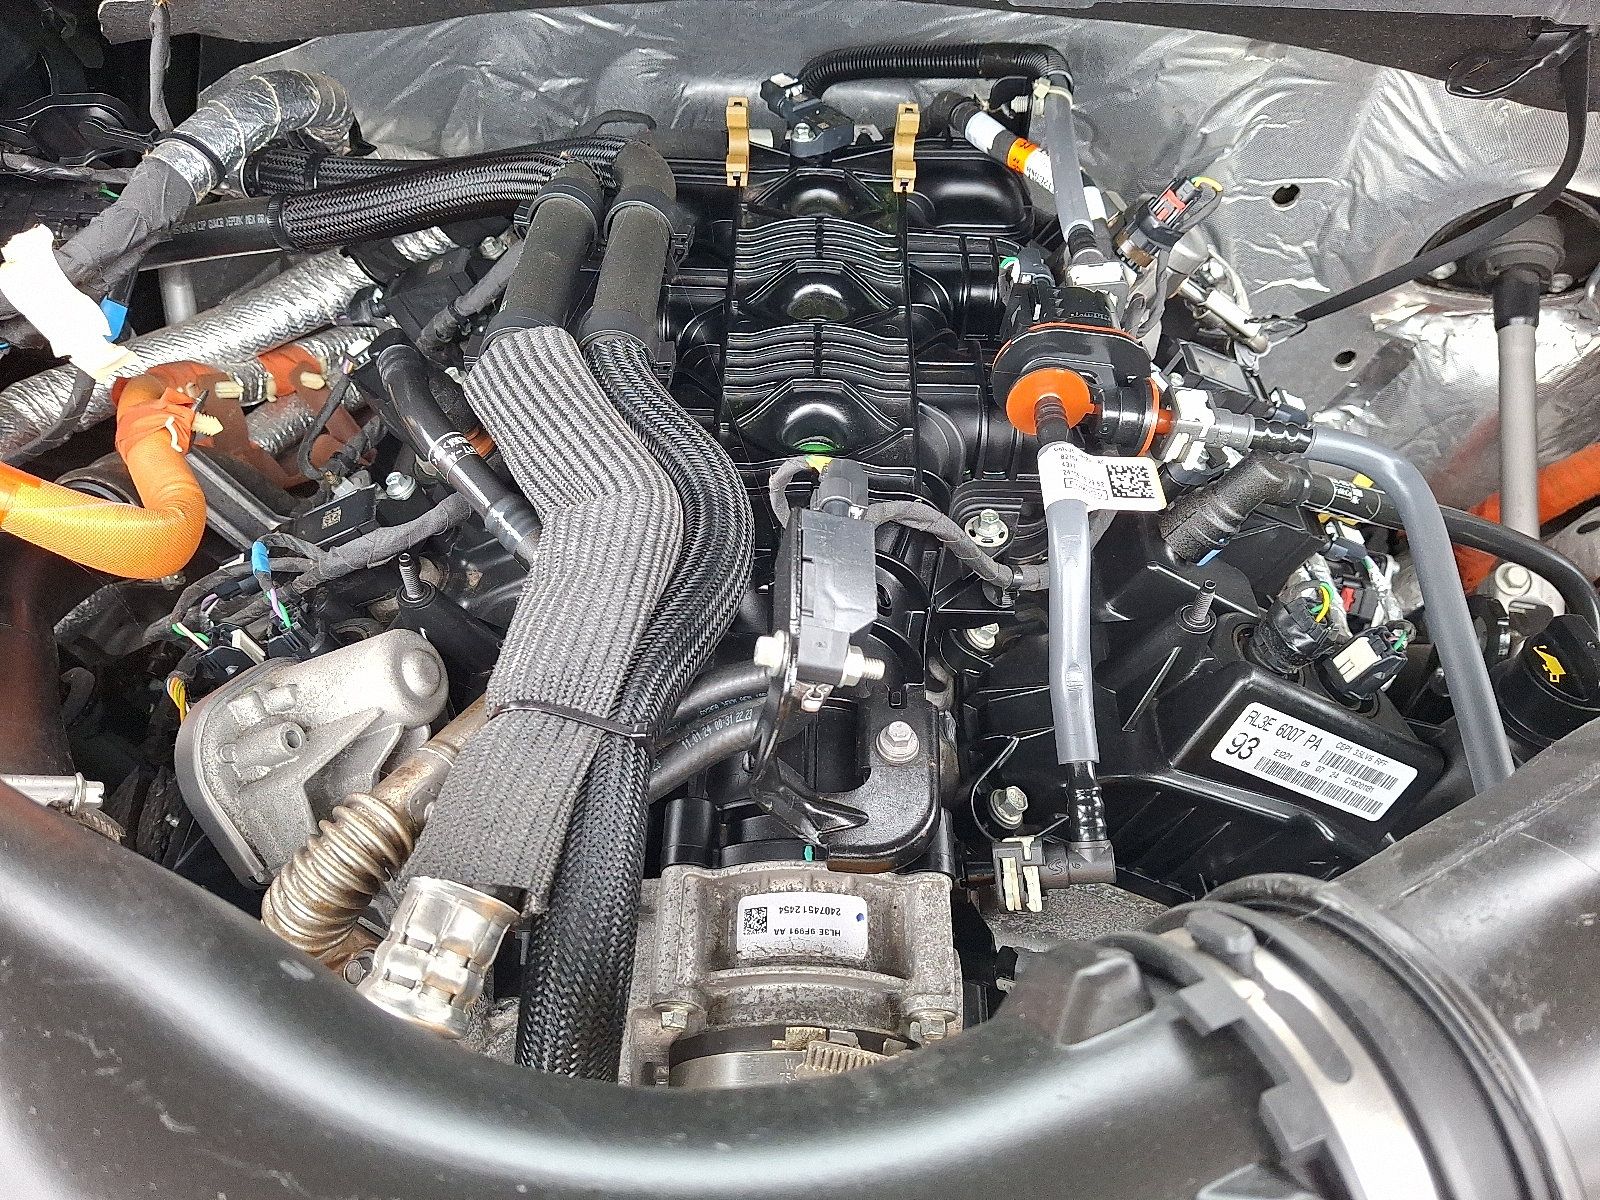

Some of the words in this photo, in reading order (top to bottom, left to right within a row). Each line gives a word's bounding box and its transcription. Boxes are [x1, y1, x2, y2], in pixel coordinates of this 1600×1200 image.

[1244, 710, 1277, 731] RL3E
[1276, 723, 1306, 742] 6007
[1303, 734, 1323, 751] PA
[1226, 732, 1260, 760] 93
[773, 928, 786, 936] AA
[789, 927, 816, 936] 9F991
[818, 928, 841, 937] HL3E
